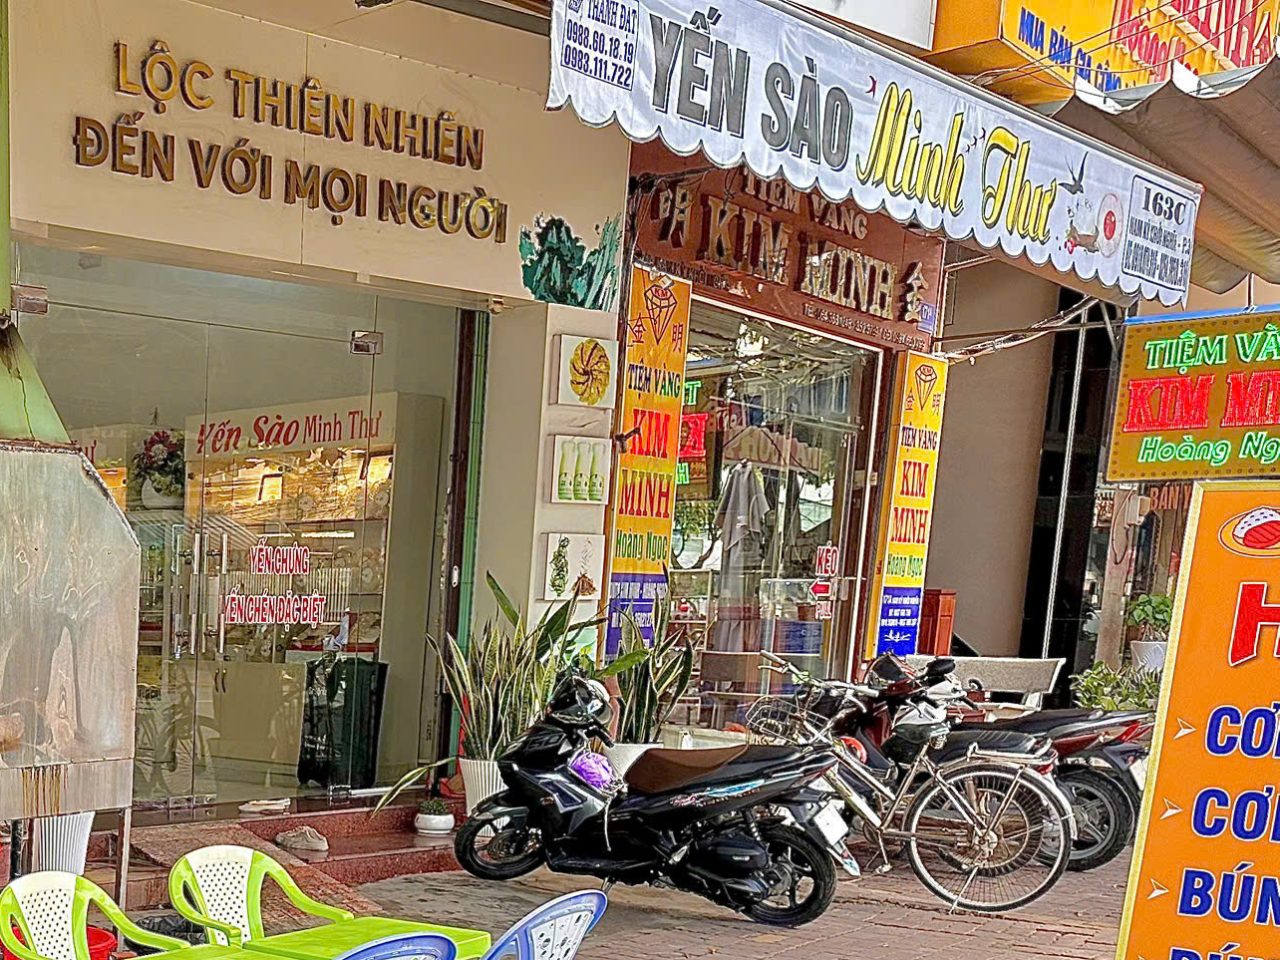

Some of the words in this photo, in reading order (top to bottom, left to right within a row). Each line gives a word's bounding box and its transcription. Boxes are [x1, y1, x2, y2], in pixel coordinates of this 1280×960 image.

[567, 19, 634, 64] 0988.60.18.19
[619, 4, 637, 39] ĐẠT
[1019, 6, 1046, 55] MUA
[1049, 25, 1074, 72] BÁN
[564, 44, 632, 87] 0983.111.722
[114, 38, 215, 114] LỘC
[225, 68, 355, 142] THIÊN
[363, 102, 485, 170] NHIÊN
[649, 6, 750, 139] YẾN
[760, 56, 853, 171] SÀO
[855, 82, 965, 216] Minh
[982, 127, 1058, 244] Thư
[72, 110, 176, 182] ĐẾN
[188, 138, 273, 200] VỚI
[284, 158, 368, 226] MỌI
[378, 178, 508, 244] NGƯỜI
[1142, 186, 1186, 225] 163C
[704, 195, 790, 286] KIM
[1145, 330, 1228, 375] TIỆM
[628, 358, 651, 399] TIỆM
[654, 363, 681, 399] VÀNG
[1122, 374, 1216, 432] KIM
[196, 419, 242, 455] Yến
[251, 413, 300, 448] Sào
[303, 413, 342, 444] Minh
[347, 410, 382, 441] Thư
[630, 408, 670, 459] KIM
[919, 424, 937, 451] VÀNG
[1138, 435, 1232, 467] Hoàng
[618, 469, 673, 518] MINH
[899, 461, 929, 499] KIM
[615, 527, 644, 561] Hoàng
[891, 507, 929, 545] MINH
[250, 537, 272, 574] YẾN
[278, 591, 299, 632] ĐẶC
[300, 589, 326, 629] BIỆT
[1205, 702, 1280, 758] CƠ
[1191, 785, 1280, 842] CƠ
[1177, 861, 1280, 926] BÚN
